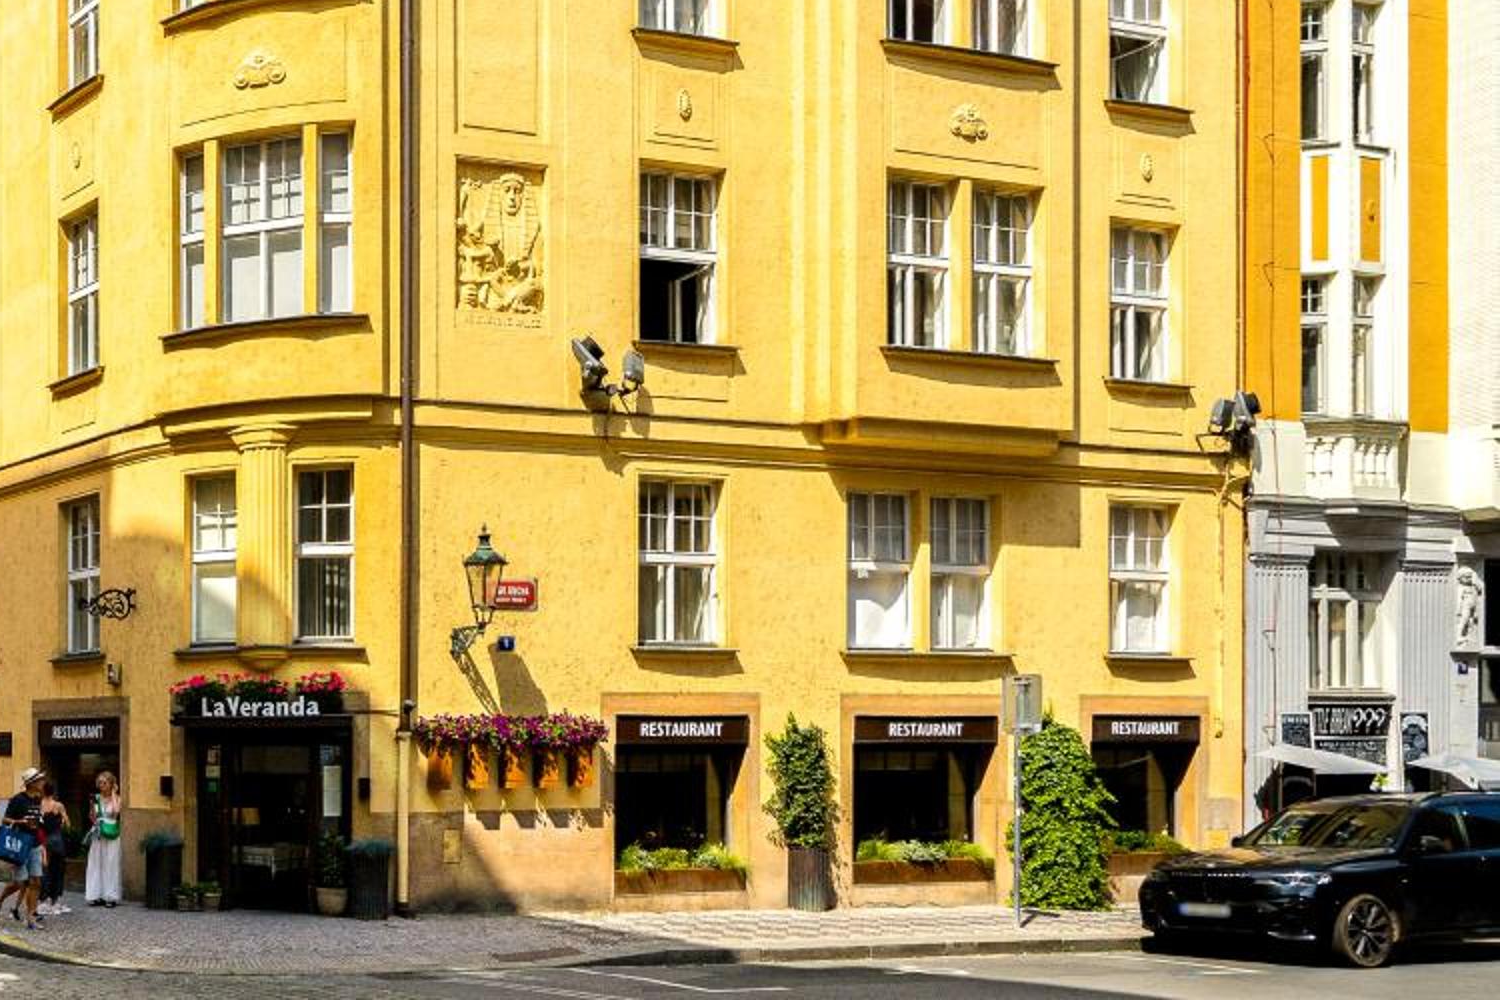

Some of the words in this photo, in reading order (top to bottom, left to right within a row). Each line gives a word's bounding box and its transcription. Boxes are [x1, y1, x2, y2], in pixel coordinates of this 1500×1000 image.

[52, 725, 104, 739] RESTAURANT
[640, 722, 724, 737] RESTAURANT
[889, 722, 963, 737] RESTAURANT
[1111, 721, 1179, 735] RESTAURANT
